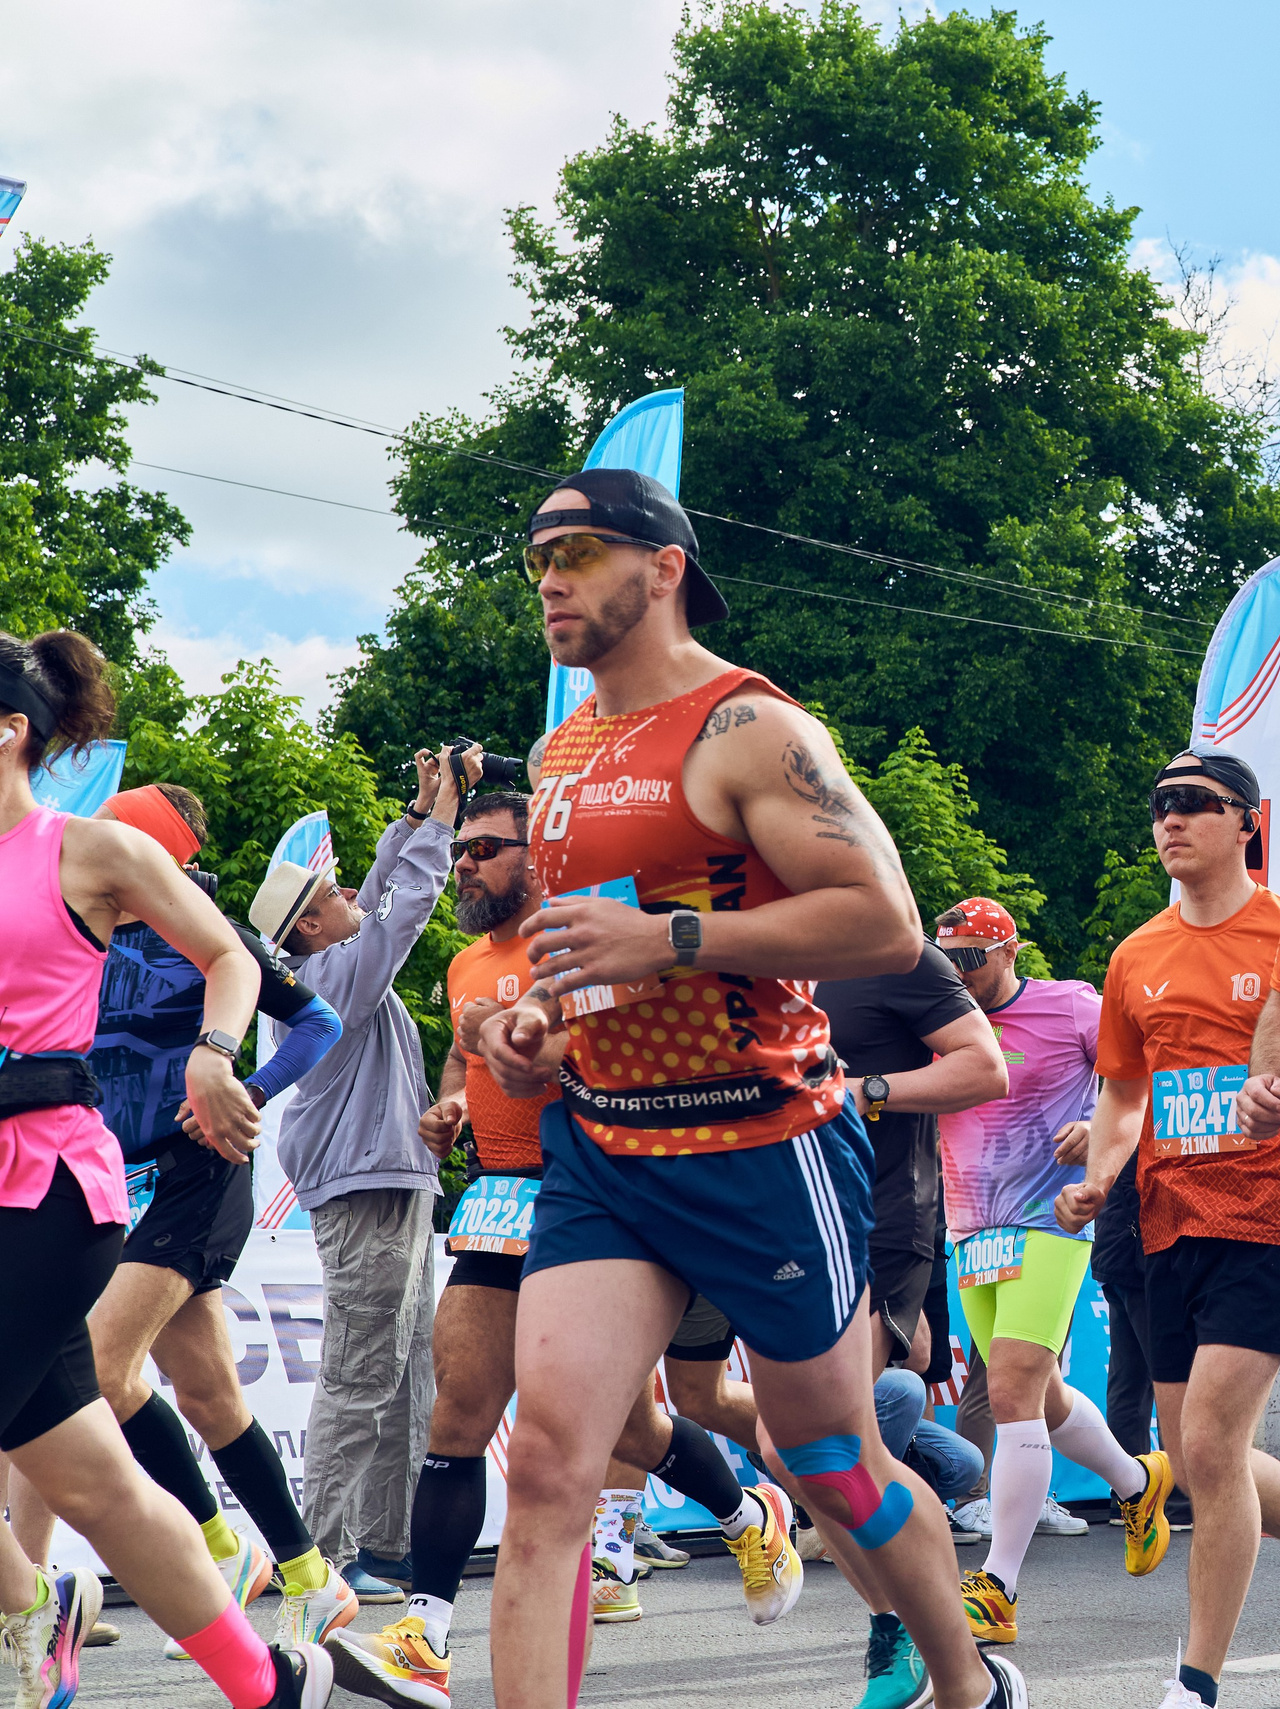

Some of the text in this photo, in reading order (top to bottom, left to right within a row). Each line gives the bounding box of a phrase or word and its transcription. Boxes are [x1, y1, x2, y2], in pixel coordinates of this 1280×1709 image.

[578, 775, 672, 806] ПОДСОЛНУХ
[527, 772, 582, 845] 76
[497, 974, 519, 1002] 10
[573, 984, 615, 1017] 21.1KM
[1230, 972, 1261, 1001] 10
[1163, 1091, 1238, 1136] 70247
[1180, 1135, 1219, 1156] 21.1KM
[457, 1197, 534, 1238] 70224
[464, 1235, 506, 1253] 21.1KM
[964, 1236, 1016, 1273] 70003
[773, 1269, 806, 1281] adidas
[974, 1269, 999, 1287] 21.1KM
